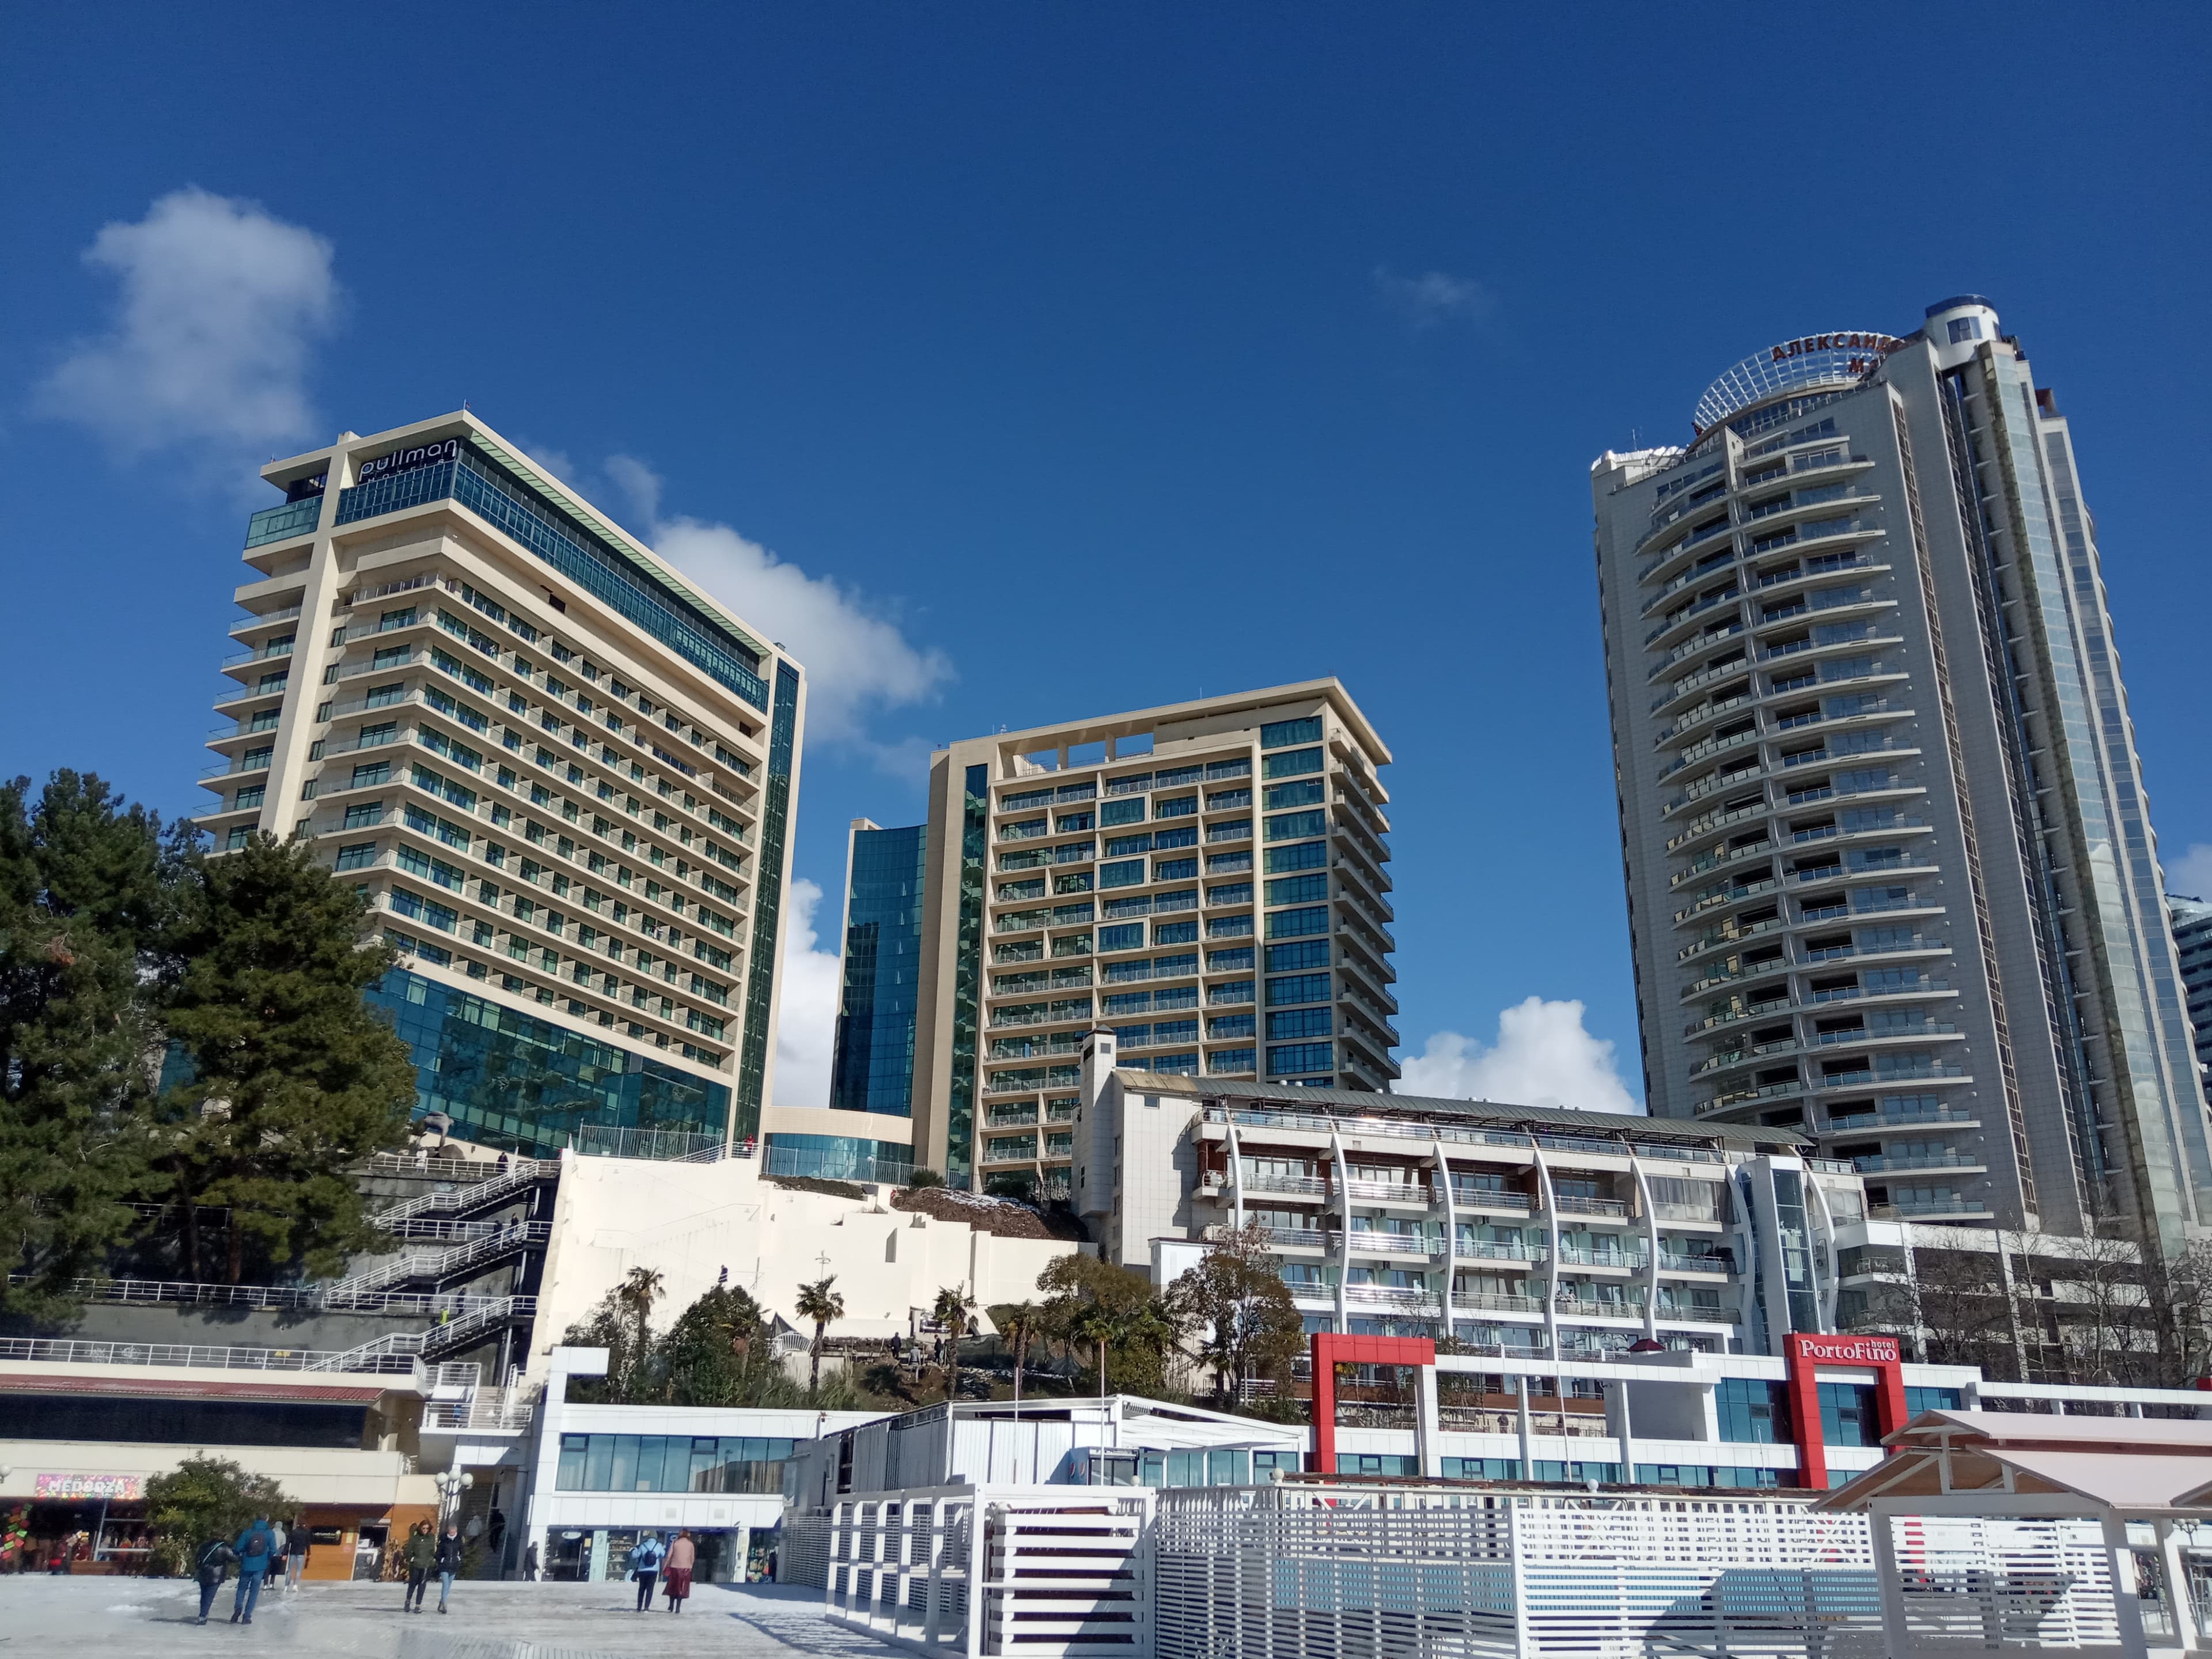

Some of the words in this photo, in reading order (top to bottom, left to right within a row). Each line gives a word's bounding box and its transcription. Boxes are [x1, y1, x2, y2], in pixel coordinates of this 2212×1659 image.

[1773, 334, 1904, 361] АЛЕКСАНД
[358, 440, 457, 482] pullman
[1800, 1340, 1897, 1361] PortoFino
[1870, 1339, 1895, 1349] hotel
